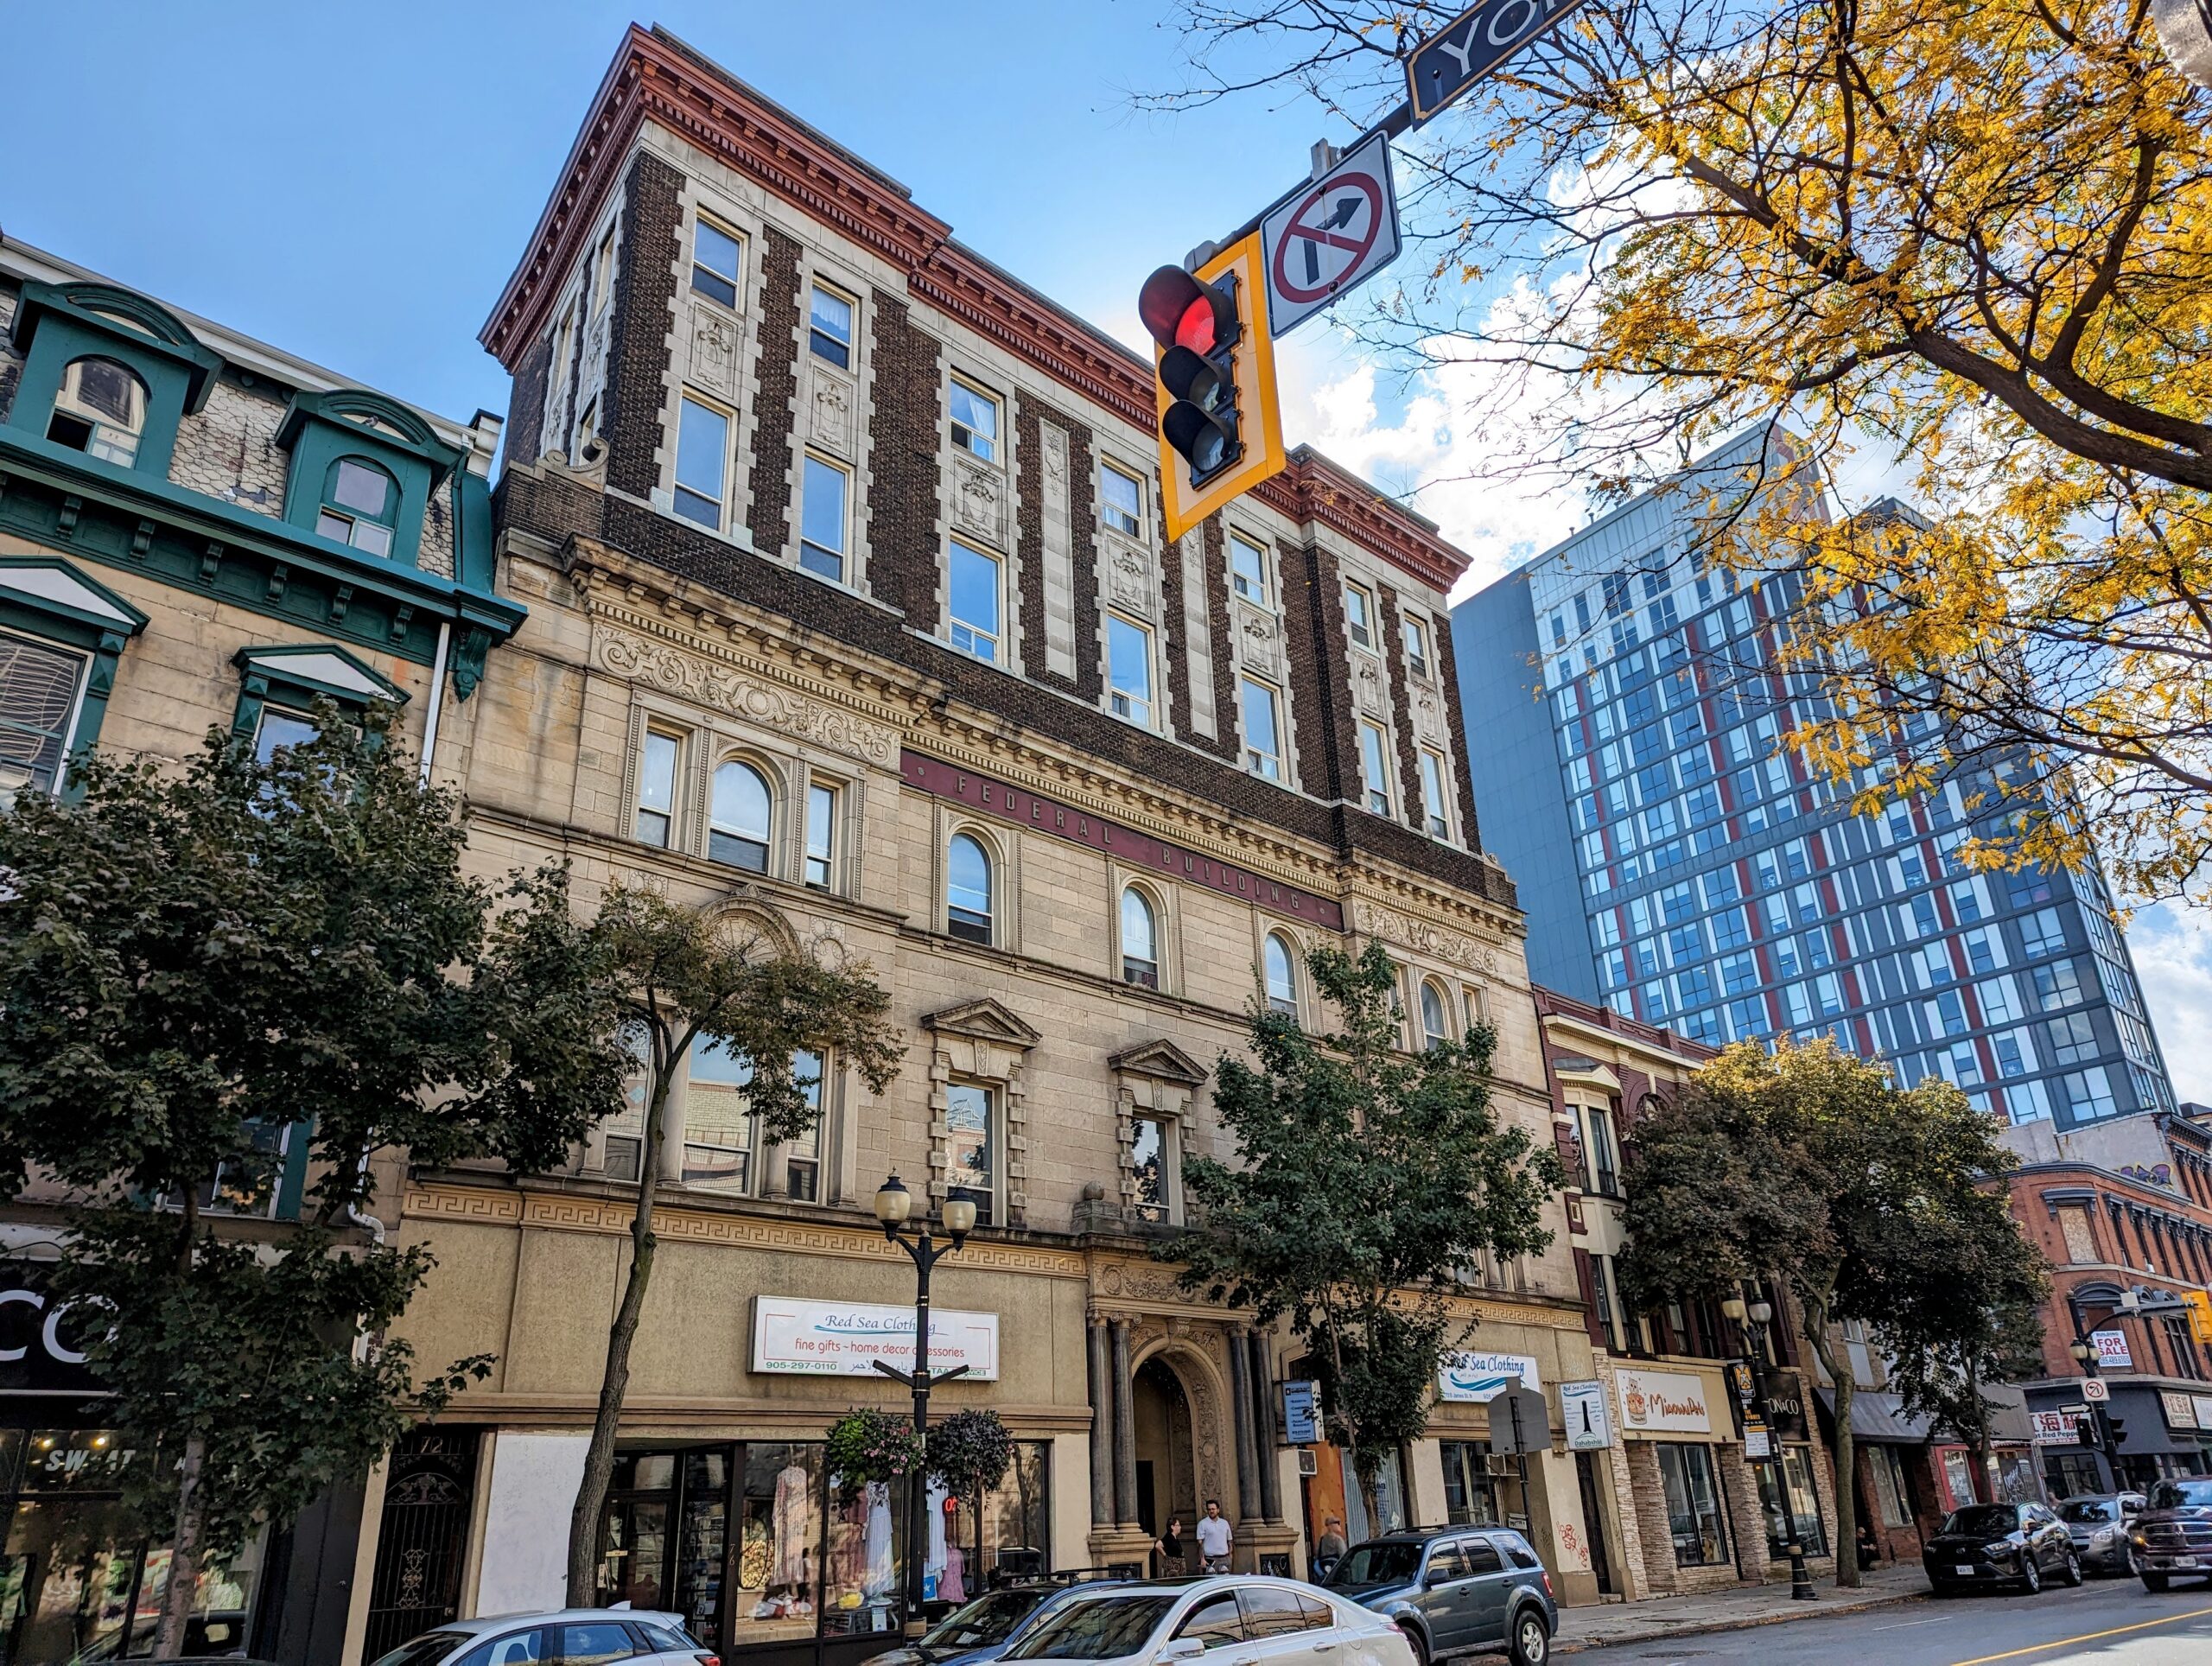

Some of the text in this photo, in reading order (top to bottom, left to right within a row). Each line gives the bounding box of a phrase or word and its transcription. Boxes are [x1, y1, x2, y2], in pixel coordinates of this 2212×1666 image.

[1438, 0, 1556, 78] YO
[956, 774, 1300, 910] FEDERAL BUILDING
[825, 1313, 936, 1337] Red Sea Clothg
[795, 1338, 815, 1351] fine
[817, 1339, 841, 1354] gifts
[850, 1341, 880, 1354] home
[882, 1343, 910, 1355] decor
[2097, 1338, 2122, 1347] FOR
[2099, 1346, 2128, 1356] SALE
[766, 1361, 837, 1370] 905-297-0110
[1471, 1356, 1485, 1371] Sea
[1488, 1356, 1525, 1377] Clothing
[1768, 1397, 1799, 1415] ON&CO
[45, 1449, 137, 1472] SWAT
